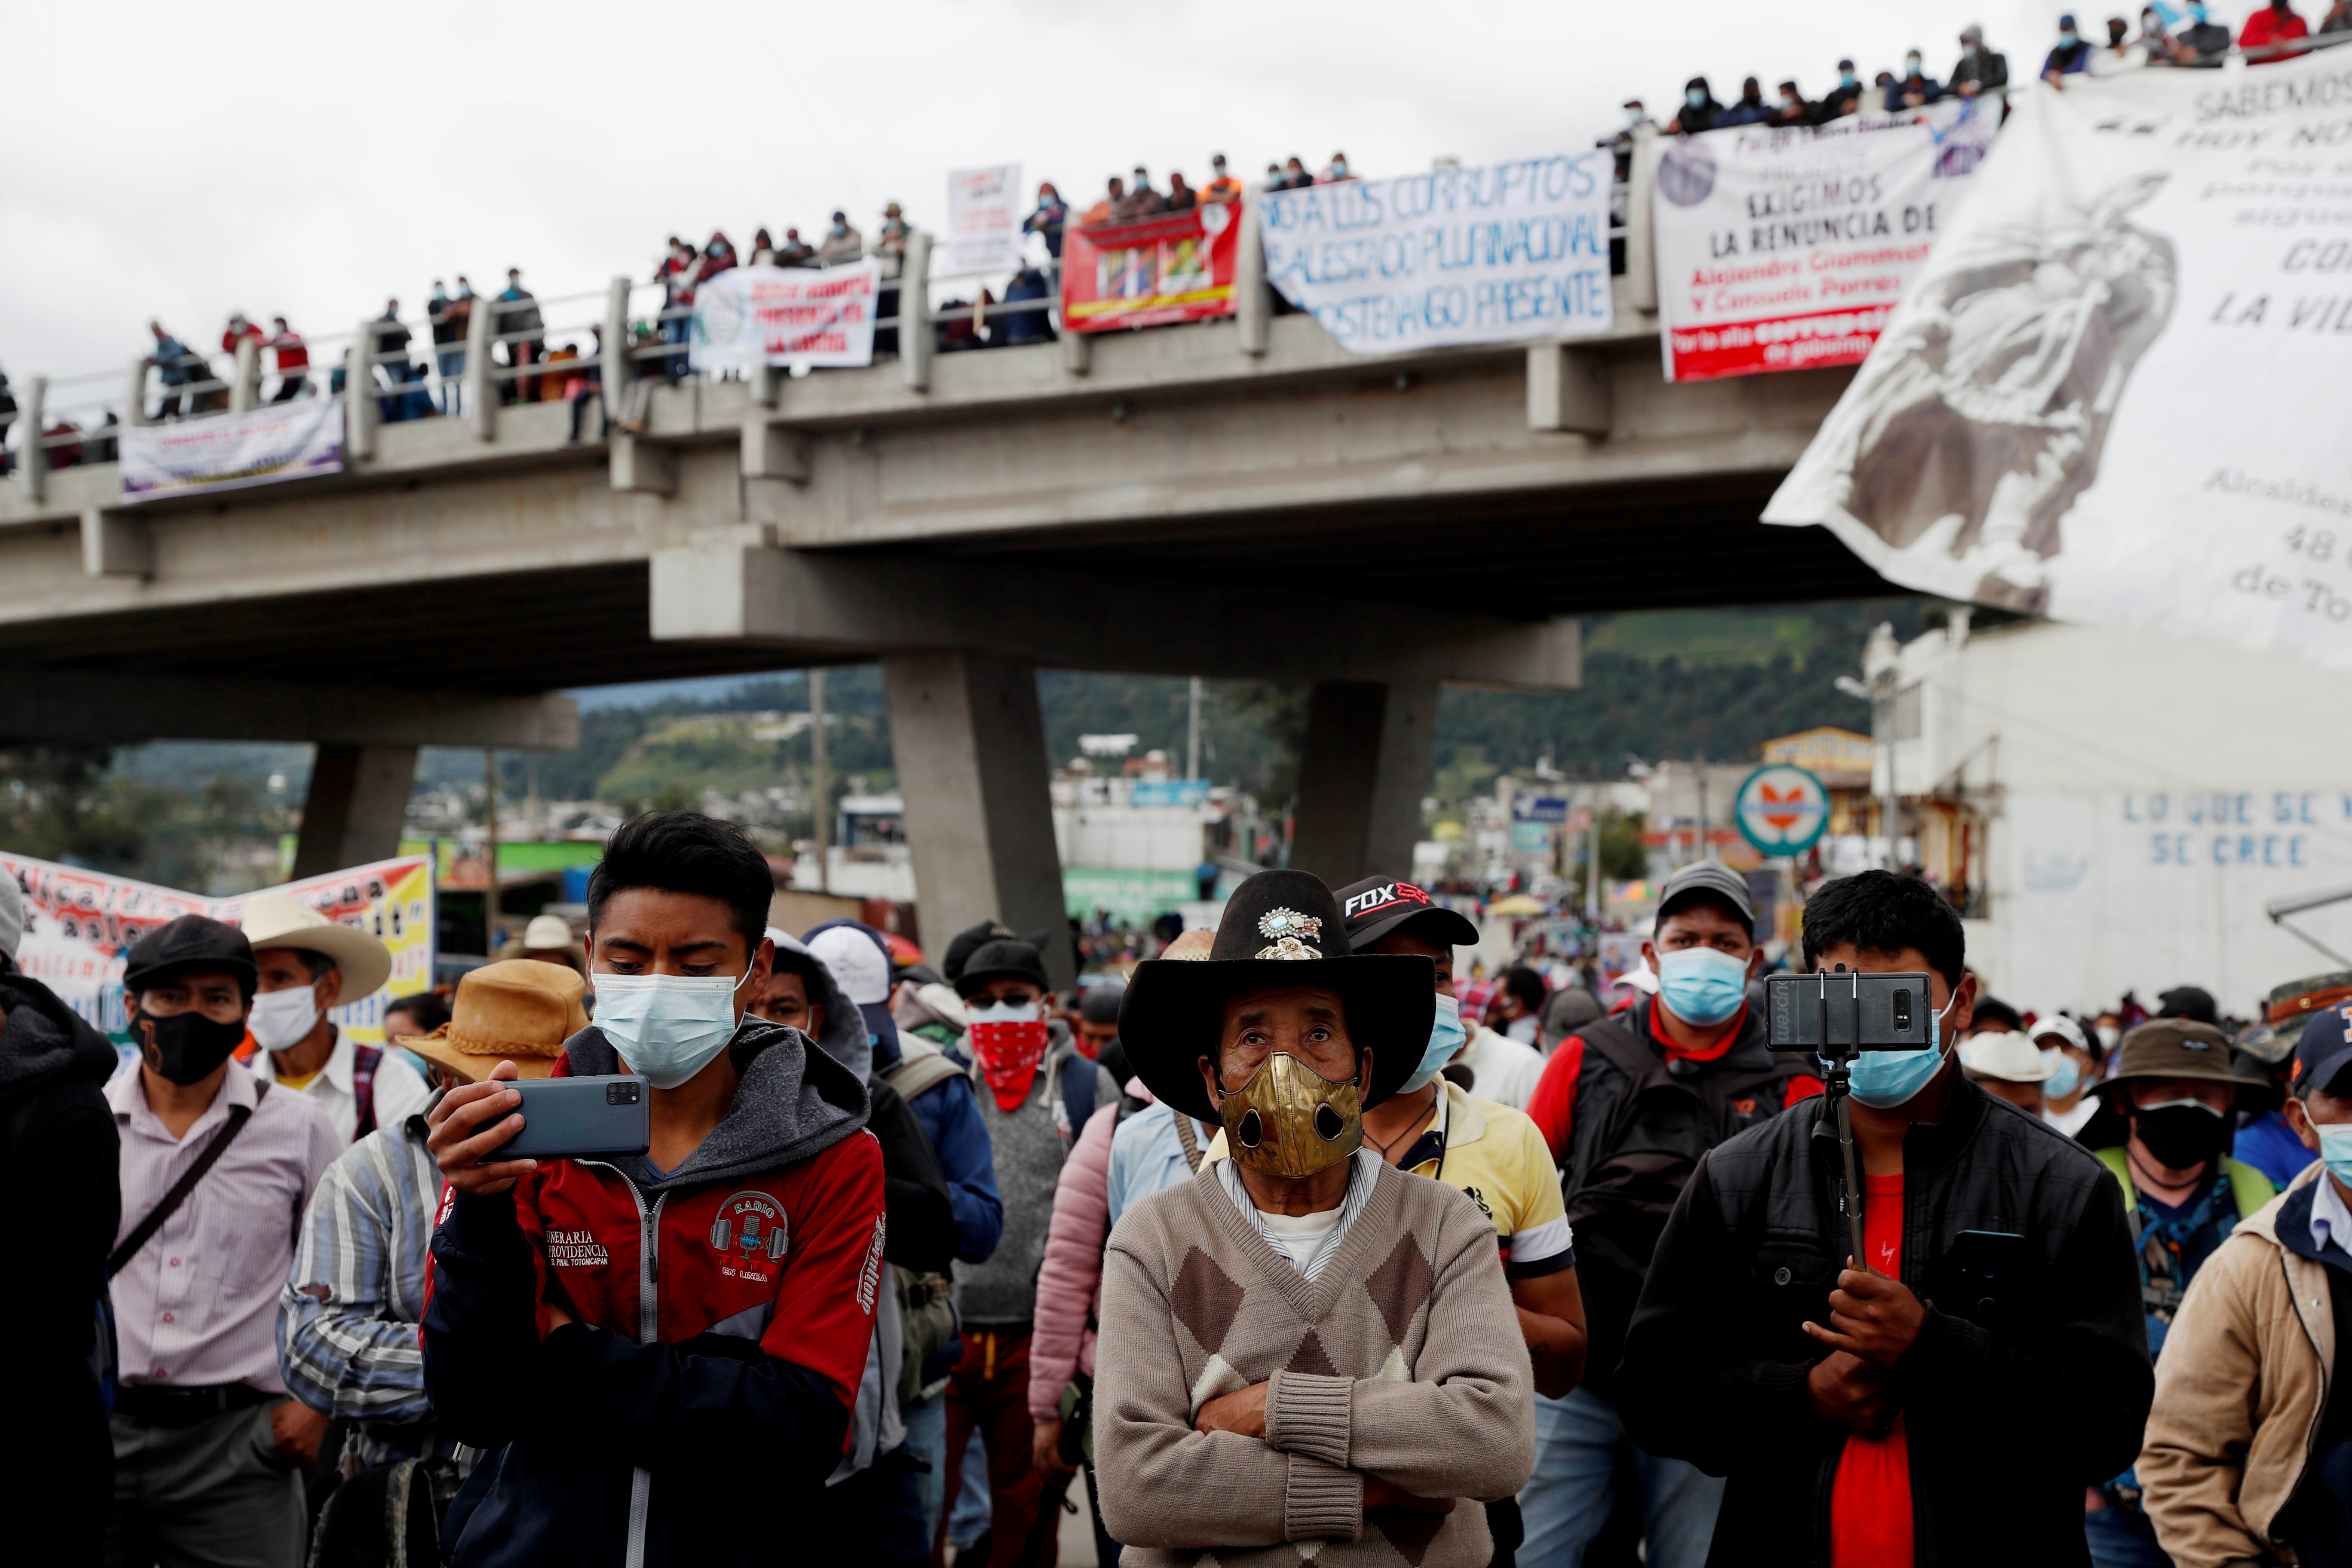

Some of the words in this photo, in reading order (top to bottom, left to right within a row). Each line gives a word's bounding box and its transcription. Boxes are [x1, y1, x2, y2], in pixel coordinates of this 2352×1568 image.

[1710, 230, 1740, 259] LA
[1750, 211, 1891, 253] RENUNCIA
[1903, 202, 1937, 233] DE
[1690, 295, 1705, 313] Y
[1345, 884, 1396, 917] FOX
[1771, 980, 1789, 1041] uprem
[734, 1200, 775, 1219] RADIO
[546, 1231, 593, 1244] UNERARIA
[548, 1245, 608, 1258] PROVIDENCIA
[571, 1257, 608, 1266] TOTONICAPAN
[722, 1267, 736, 1277] EN
[739, 1270, 767, 1282] LINEA
